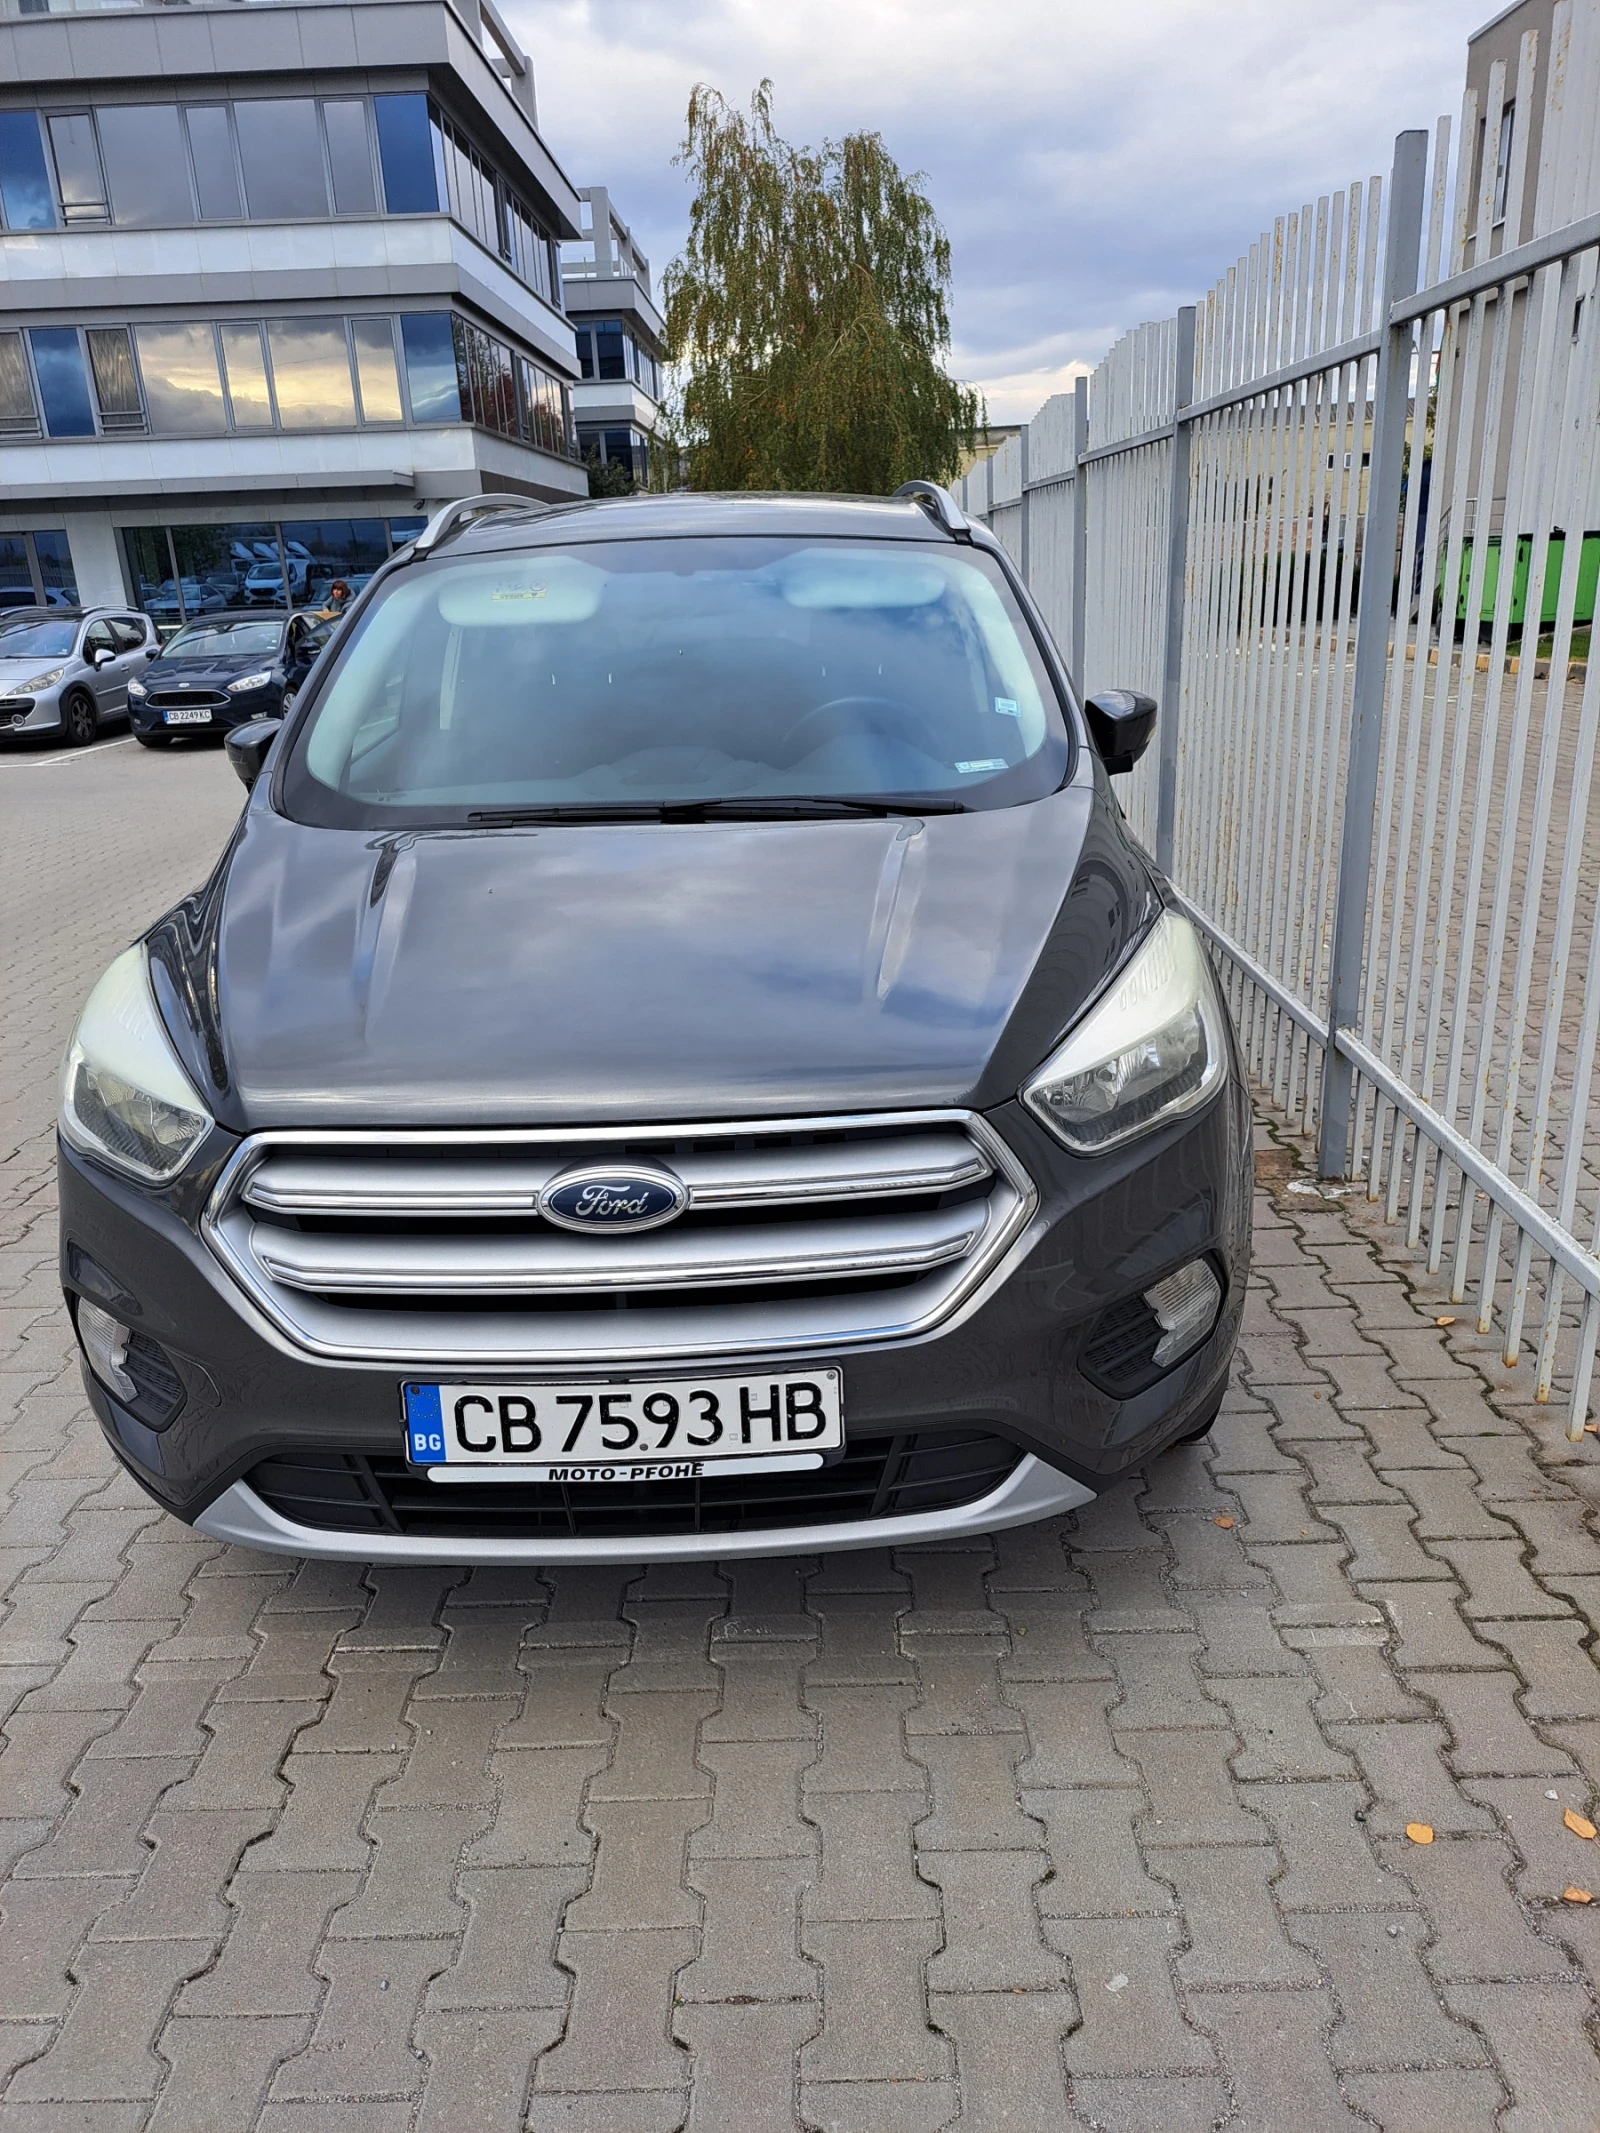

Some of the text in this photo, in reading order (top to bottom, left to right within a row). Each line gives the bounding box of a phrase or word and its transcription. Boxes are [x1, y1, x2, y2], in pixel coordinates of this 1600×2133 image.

[575, 1185, 649, 1216] Ford
[454, 1381, 827, 1453] CB 7593 HB
[414, 1433, 442, 1451] BG
